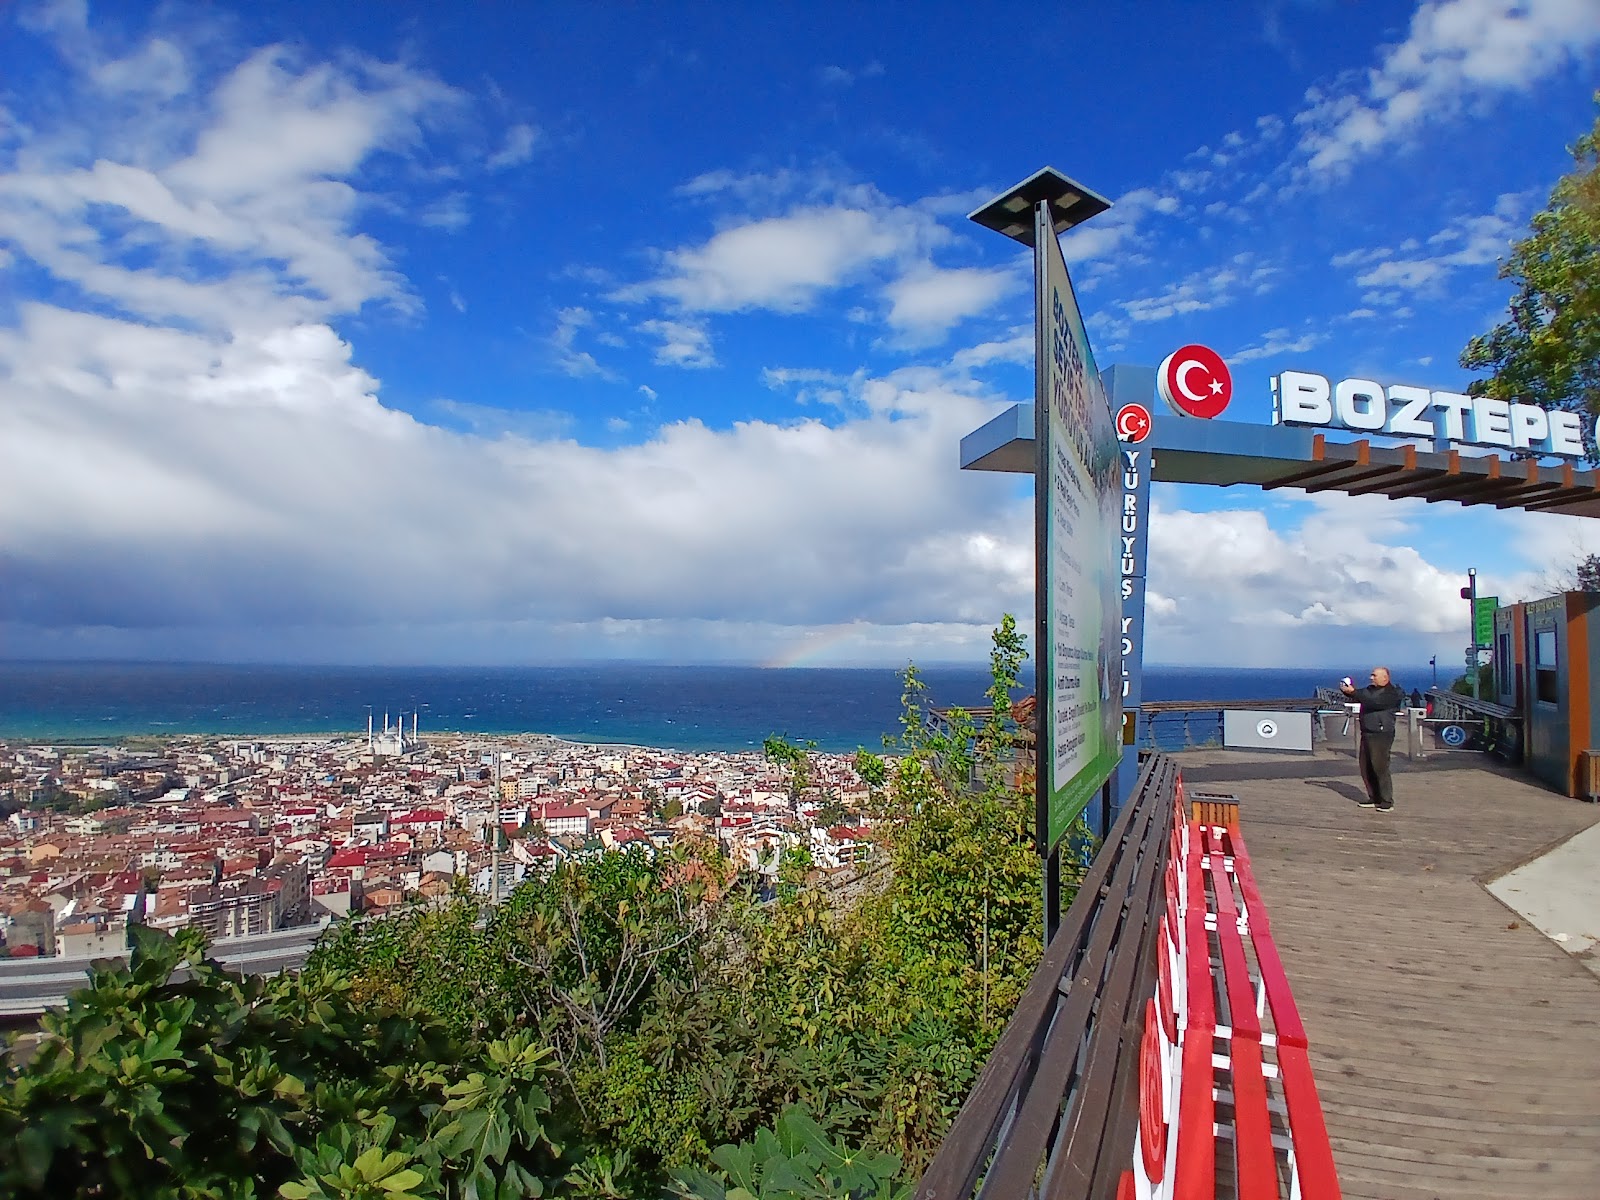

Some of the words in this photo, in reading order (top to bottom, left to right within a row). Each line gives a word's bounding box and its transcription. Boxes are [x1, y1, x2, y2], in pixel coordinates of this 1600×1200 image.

[1053, 285, 1083, 389] BOZTEPE
[1280, 370, 1585, 456] BOZTEPE
[1121, 451, 1140, 600] YÜRÜYÜŞ
